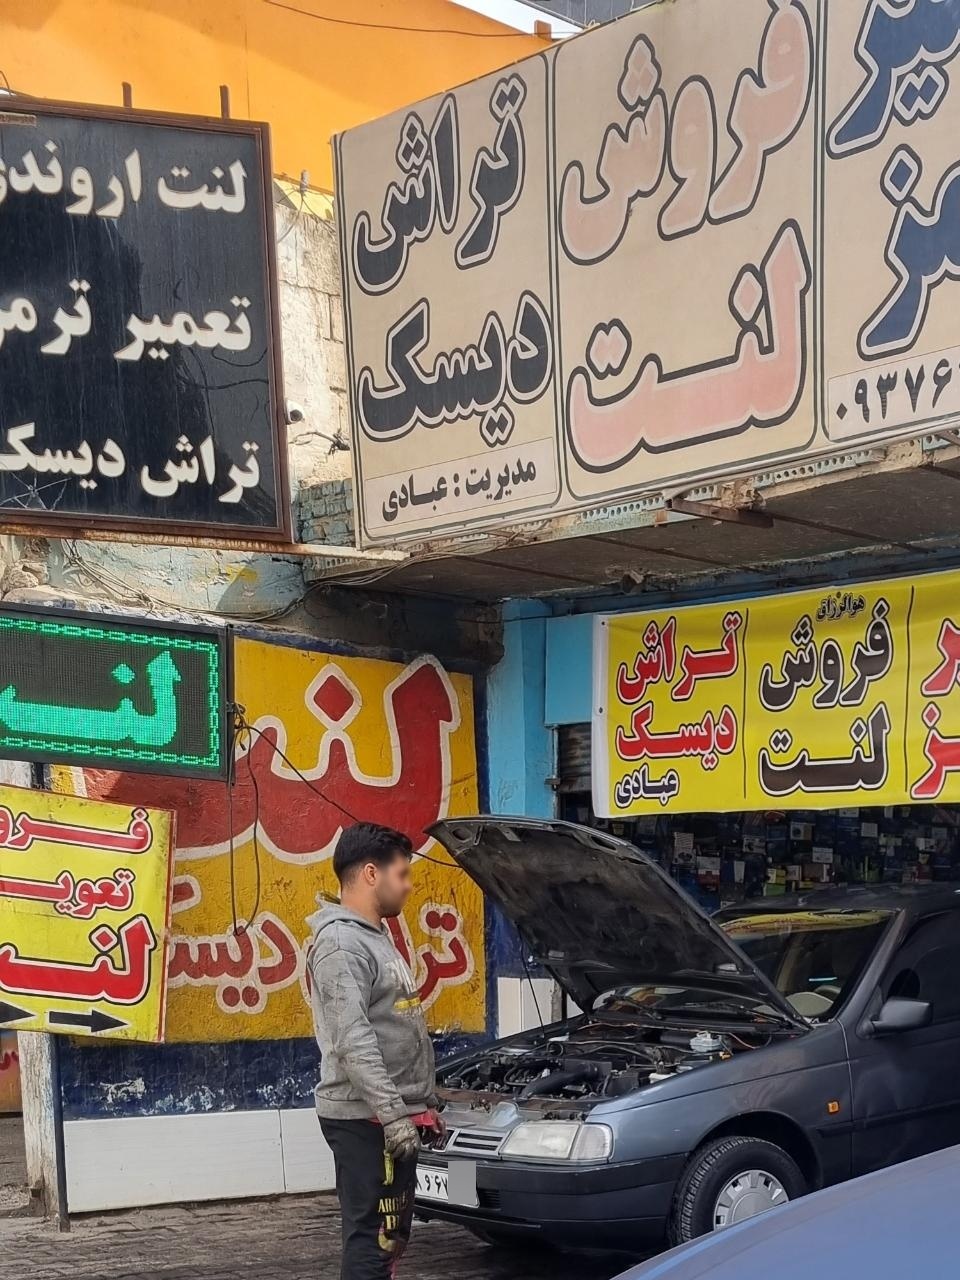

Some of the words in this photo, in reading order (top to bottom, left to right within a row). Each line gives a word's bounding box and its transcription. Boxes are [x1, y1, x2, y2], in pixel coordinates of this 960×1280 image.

[558, 0, 813, 265] فروش
[0, 139, 142, 218] اروند
[157, 159, 247, 213] لنت
[352, 72, 527, 294] تراش
[0, 278, 92, 355] ترم
[114, 295, 251, 361] تعمیر
[565, 219, 811, 473] لنت
[356, 290, 554, 446] دیسک
[141, 434, 260, 503] تراش
[382, 473, 448, 522] عبادی
[465, 457, 537, 501] مدیریت
[616, 611, 742, 704] تراش
[758, 598, 894, 711] فروش
[0, 650, 182, 747] لن
[615, 703, 738, 769] دیسک
[614, 764, 681, 807] عبادی
[757, 702, 892, 797] لنت
[0, 868, 135, 921] تعوی
[0, 914, 157, 1006] لن
